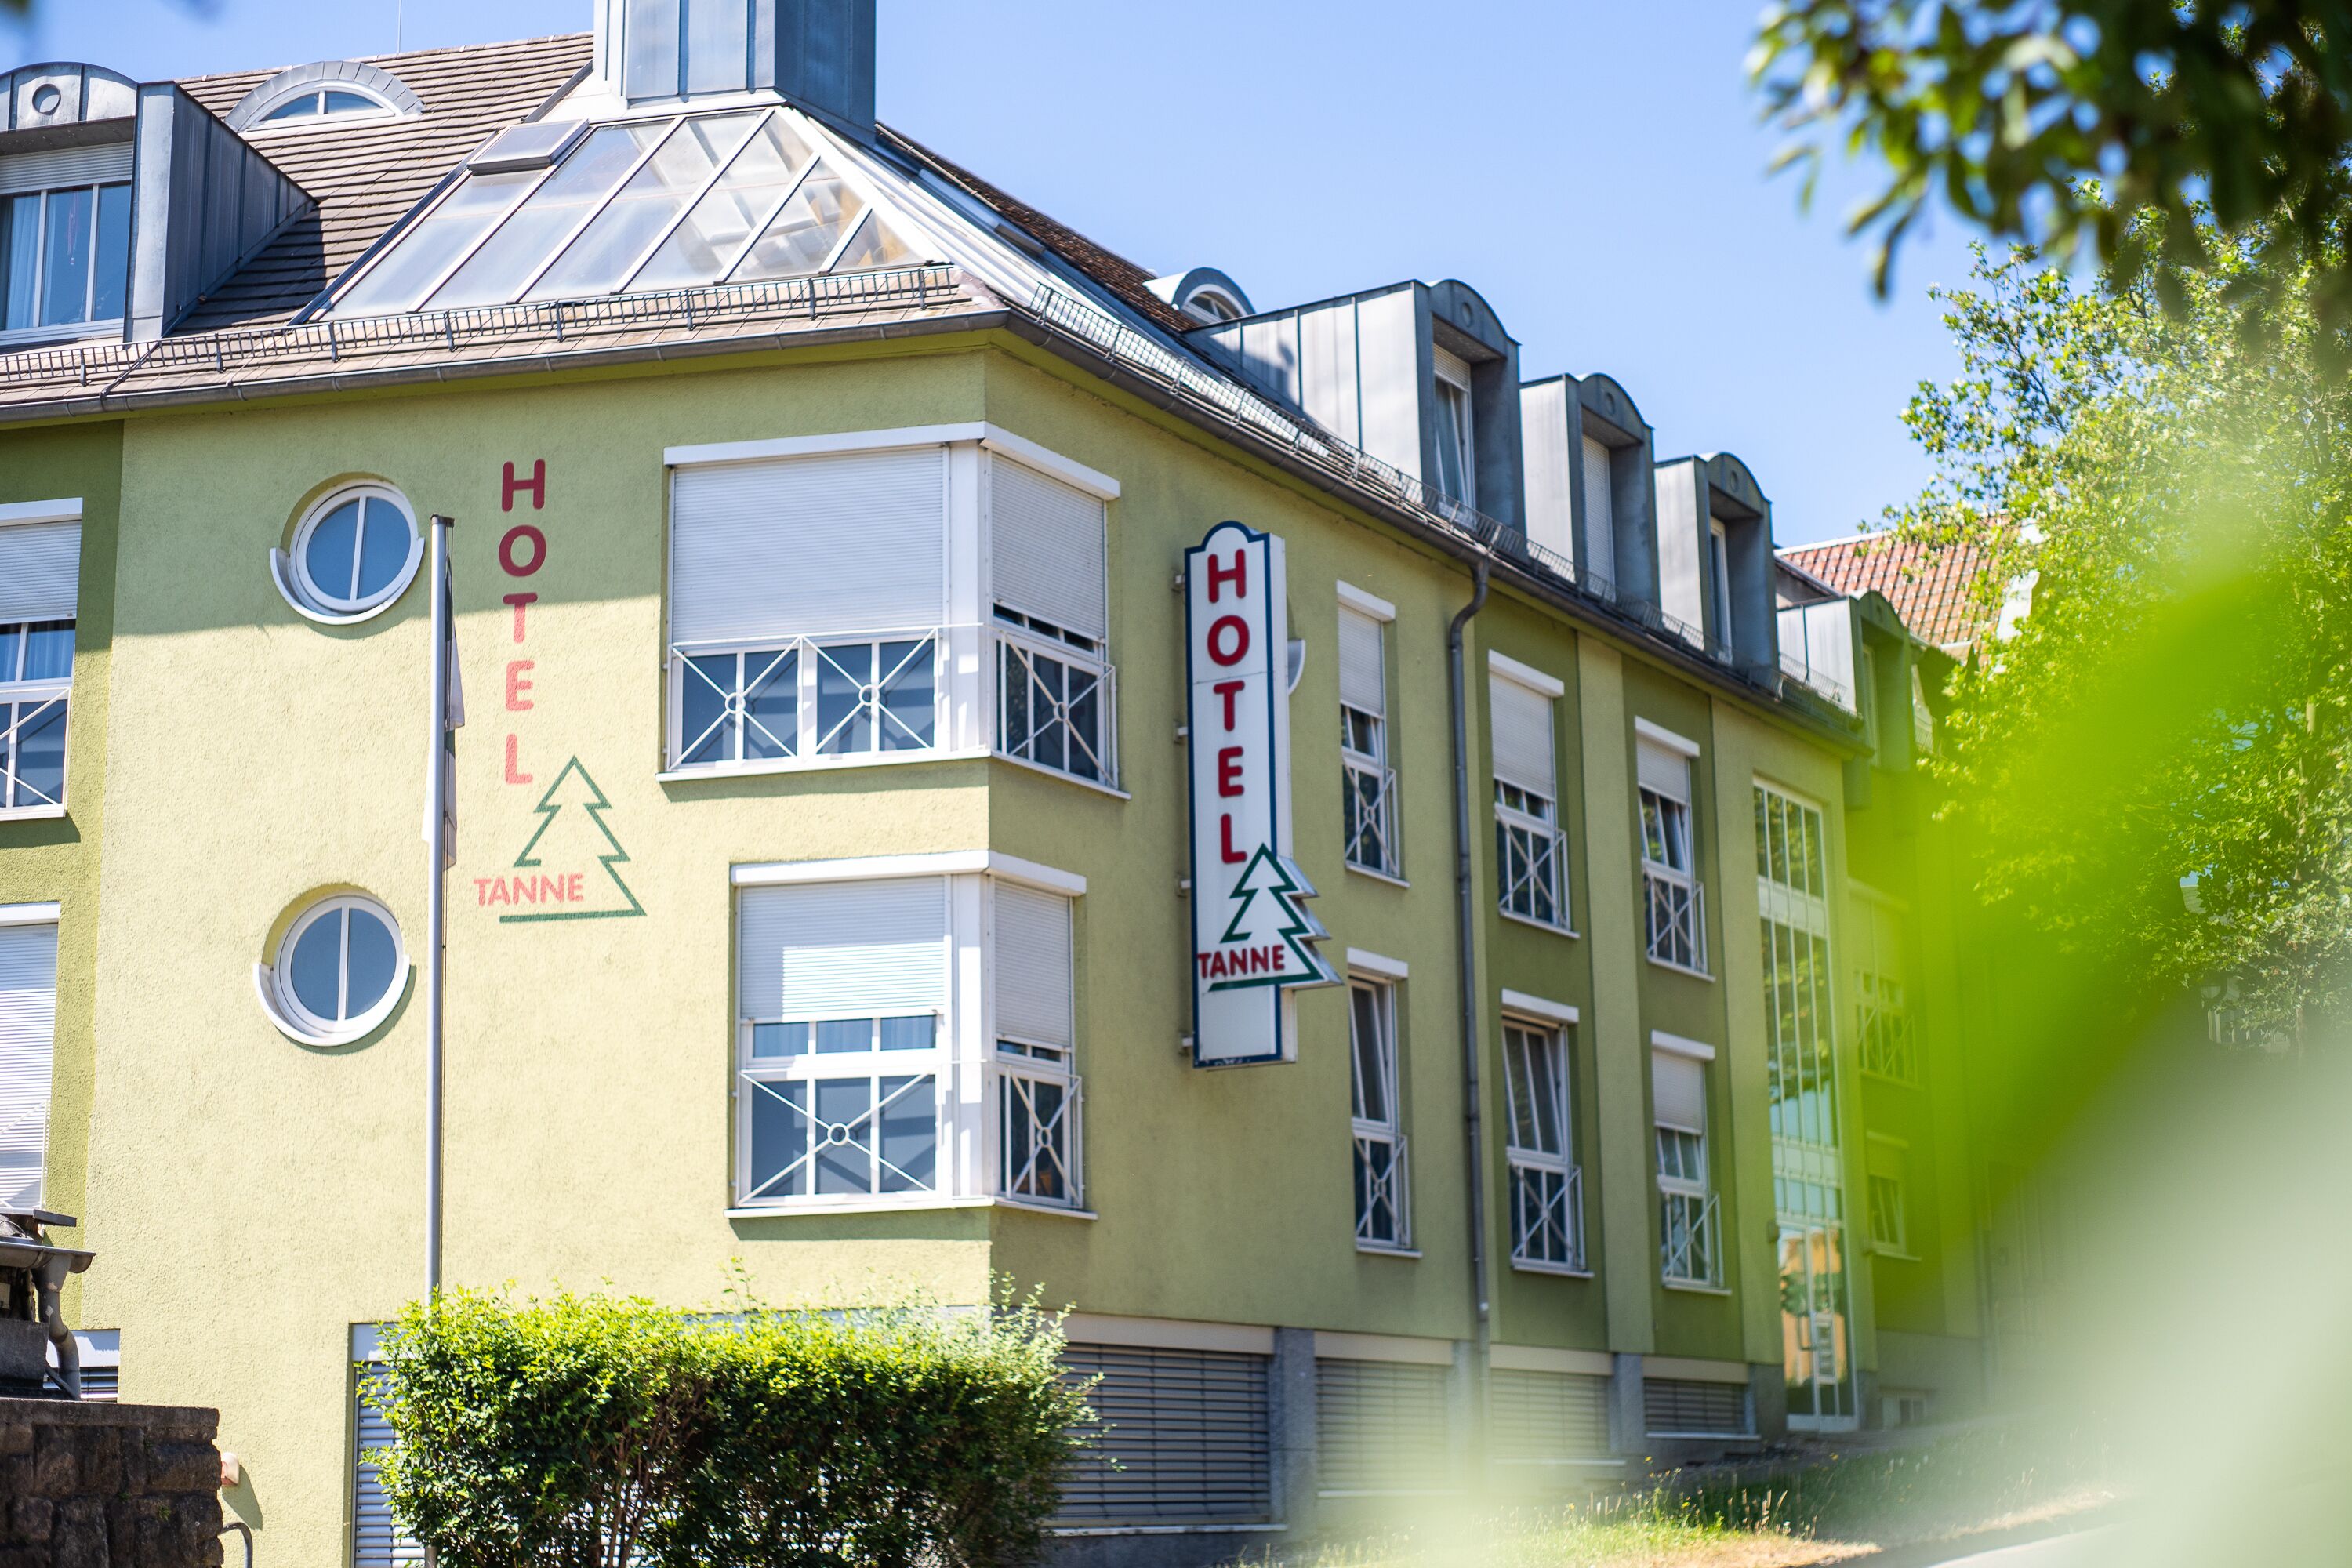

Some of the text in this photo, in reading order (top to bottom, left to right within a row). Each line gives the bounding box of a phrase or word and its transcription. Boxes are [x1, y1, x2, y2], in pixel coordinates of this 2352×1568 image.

[499, 459, 546, 786] HOTEL
[1207, 548, 1250, 864] HOTEL
[473, 873, 584, 906] TANNE
[1197, 943, 1285, 978] TANNE
